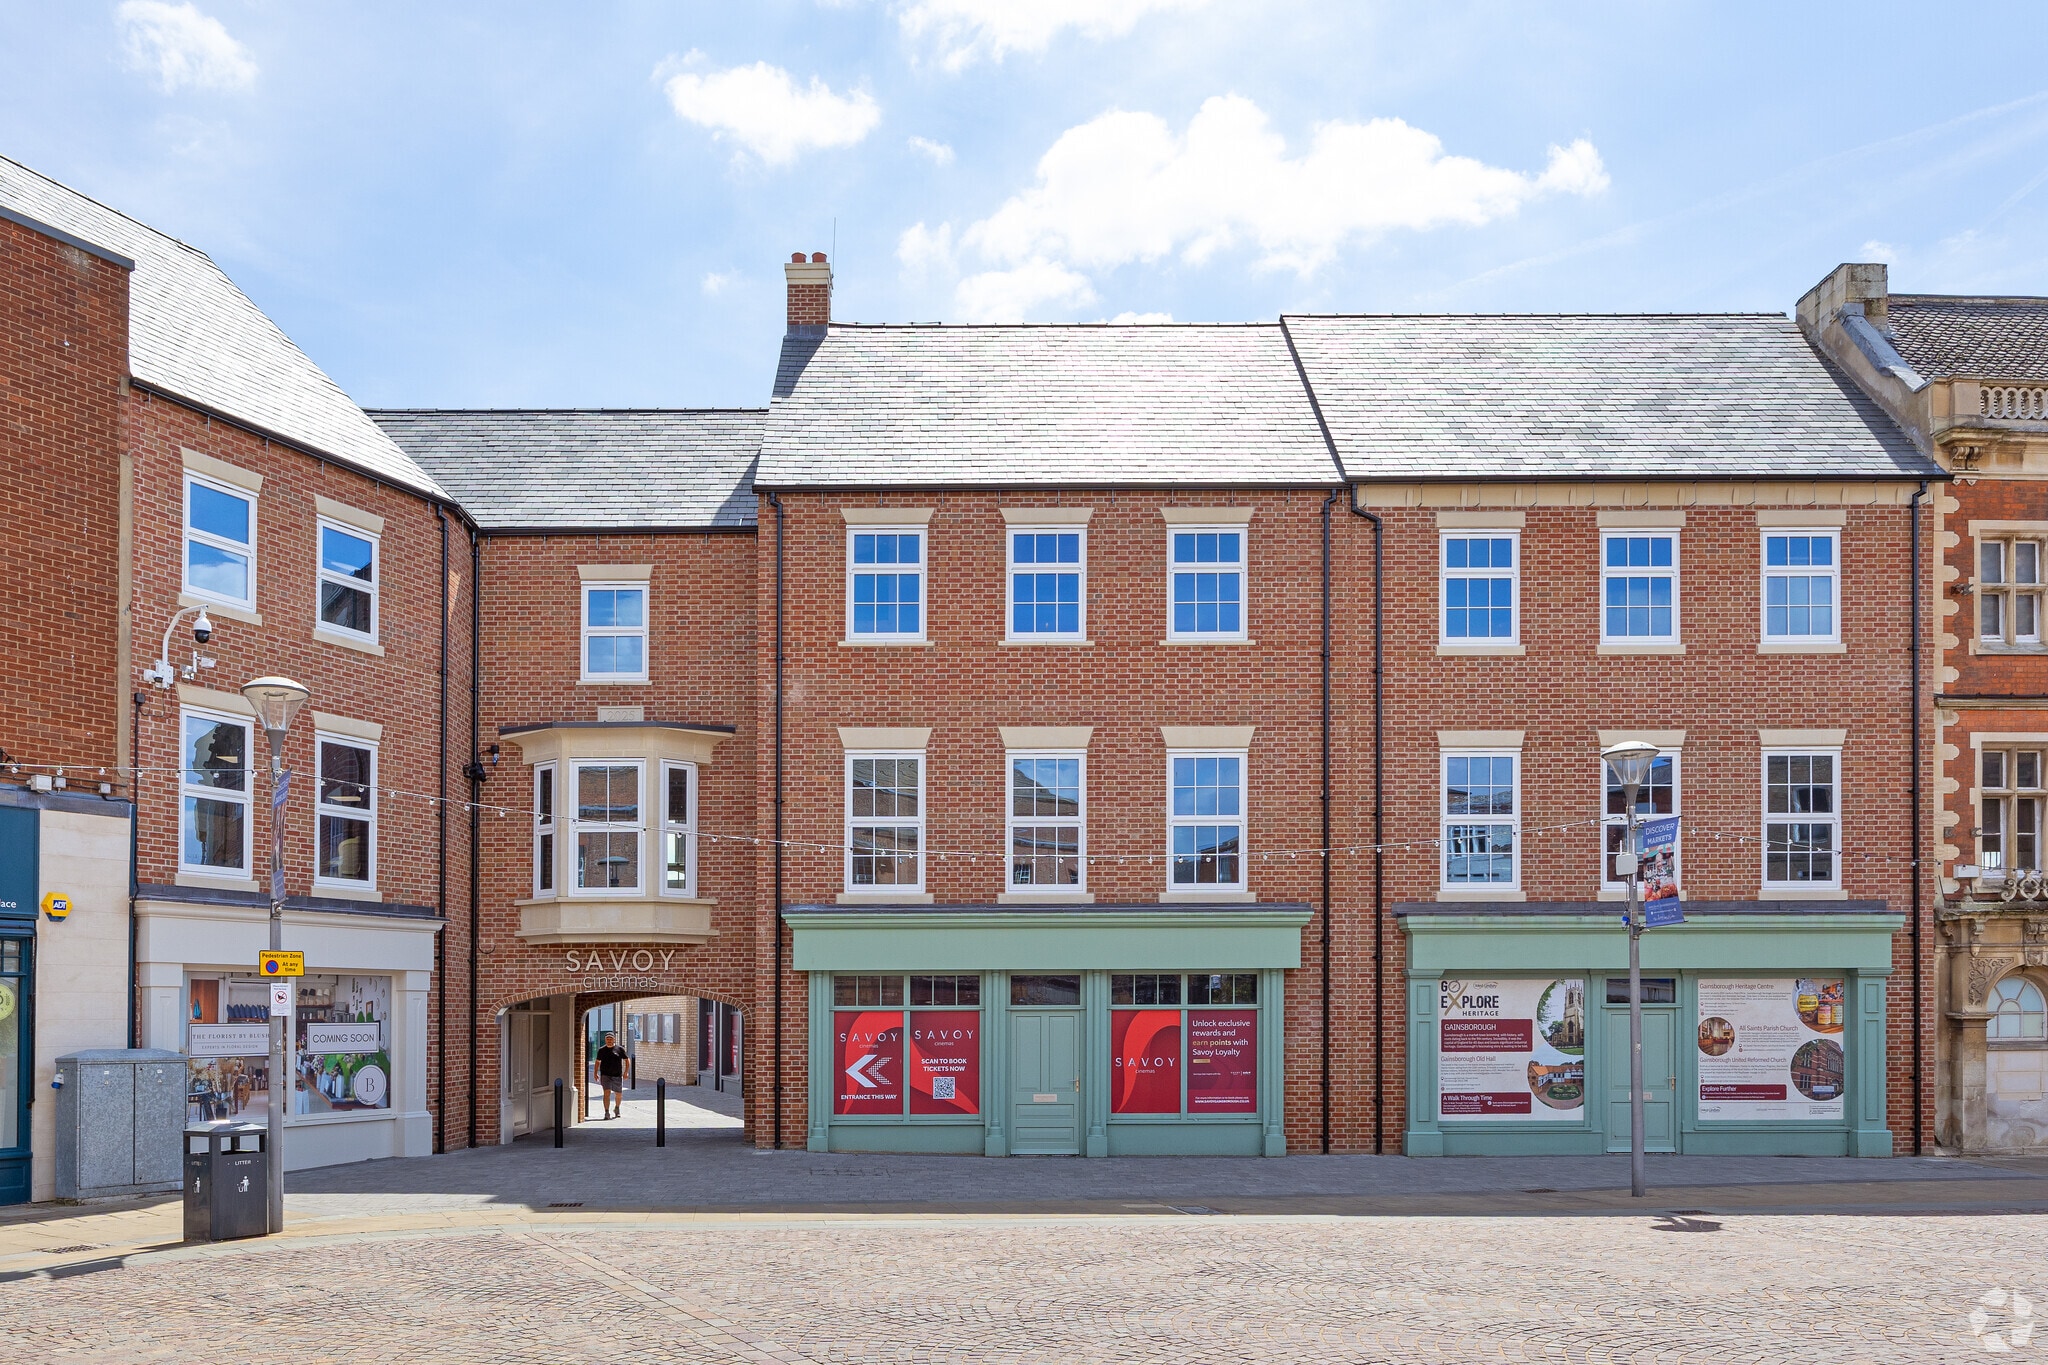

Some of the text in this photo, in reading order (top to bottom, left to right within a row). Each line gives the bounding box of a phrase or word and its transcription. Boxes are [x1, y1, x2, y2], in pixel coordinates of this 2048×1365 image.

[608, 711, 635, 721] 2025
[1645, 823, 1675, 836] DISCOVER
[1647, 833, 1672, 845] MARKETS
[0, 899, 17, 908] ace
[53, 901, 67, 909] ADT
[565, 949, 676, 972] SAVOY
[582, 974, 658, 989] cinemas
[1218, 1019, 1250, 1027] exclusive
[1444, 1023, 1497, 1031] GAINSBOROUGH
[312, 1033, 374, 1043] COMING SOON
[840, 1032, 898, 1042] SAVOY
[914, 1029, 973, 1040] SAVOY
[1192, 1029, 1221, 1037] rewards
[1209, 1039, 1231, 1047] points
[1192, 1048, 1240, 1057] Savoy Loyalty
[1115, 1057, 1175, 1067] SAVOY
[365, 1077, 375, 1092] B
